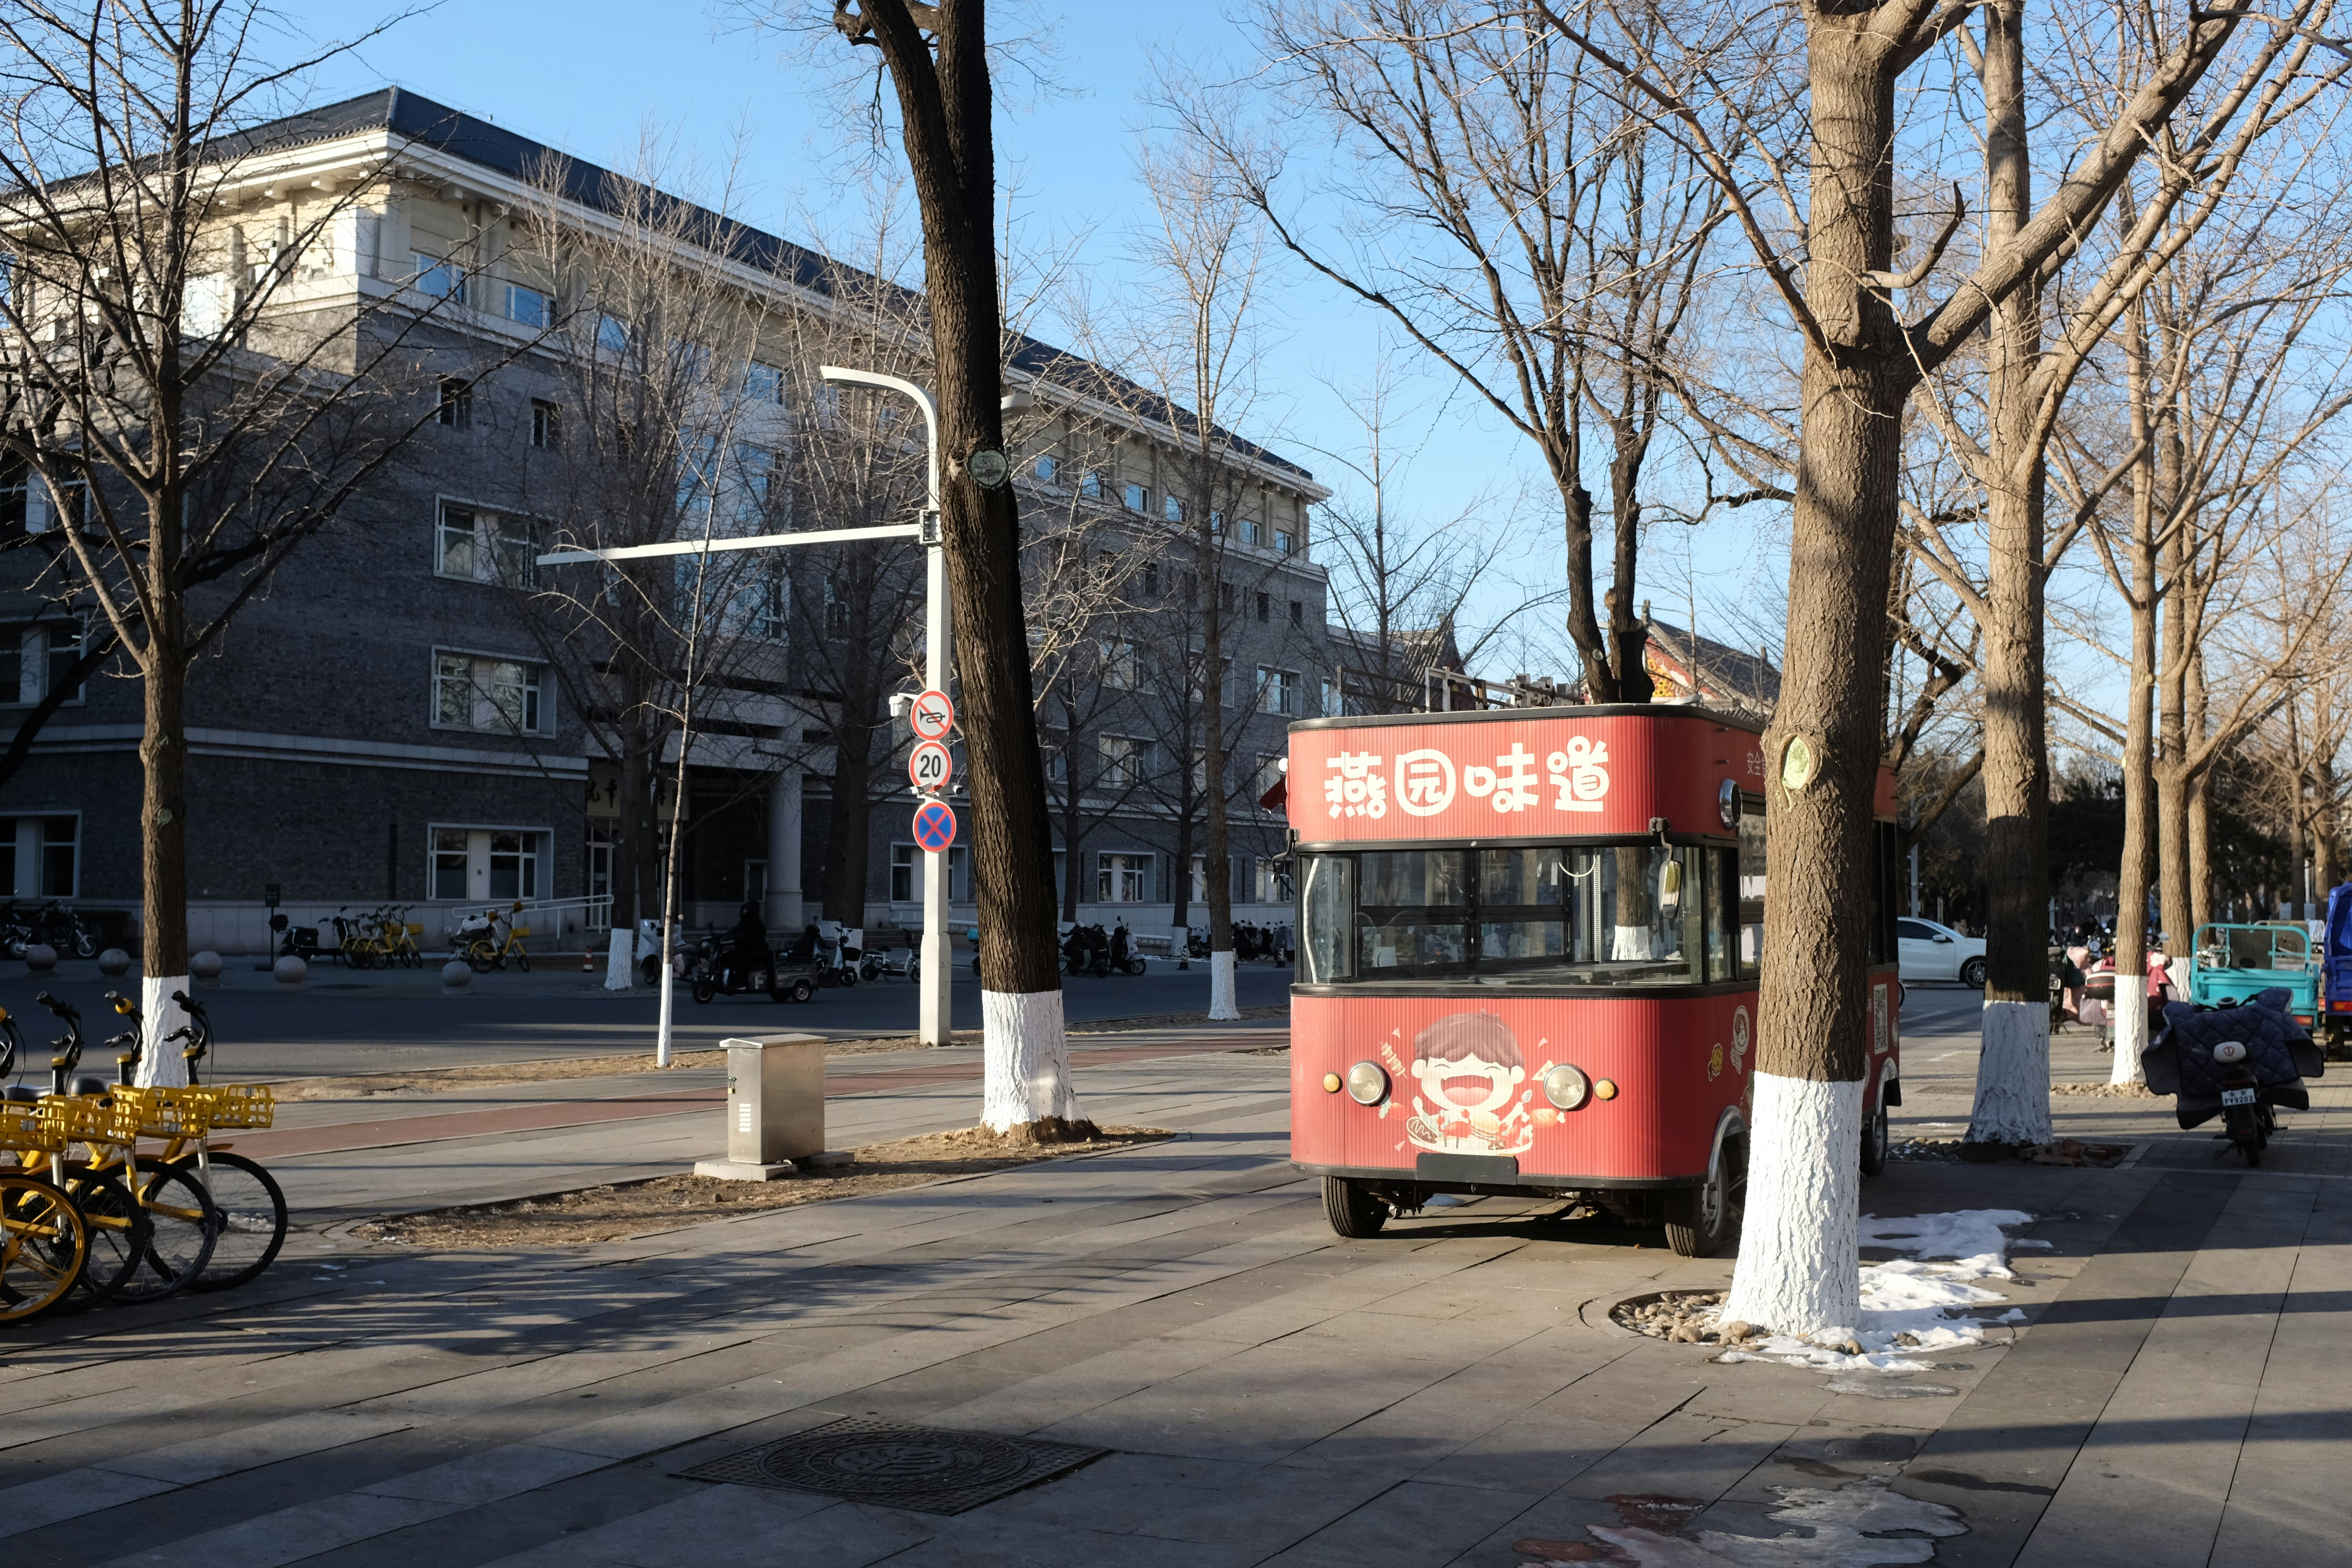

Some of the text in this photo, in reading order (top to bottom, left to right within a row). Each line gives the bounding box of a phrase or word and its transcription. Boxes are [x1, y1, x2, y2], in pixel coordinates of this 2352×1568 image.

[919, 755, 941, 778] 20
[1324, 735, 1610, 819] 燕园味道
